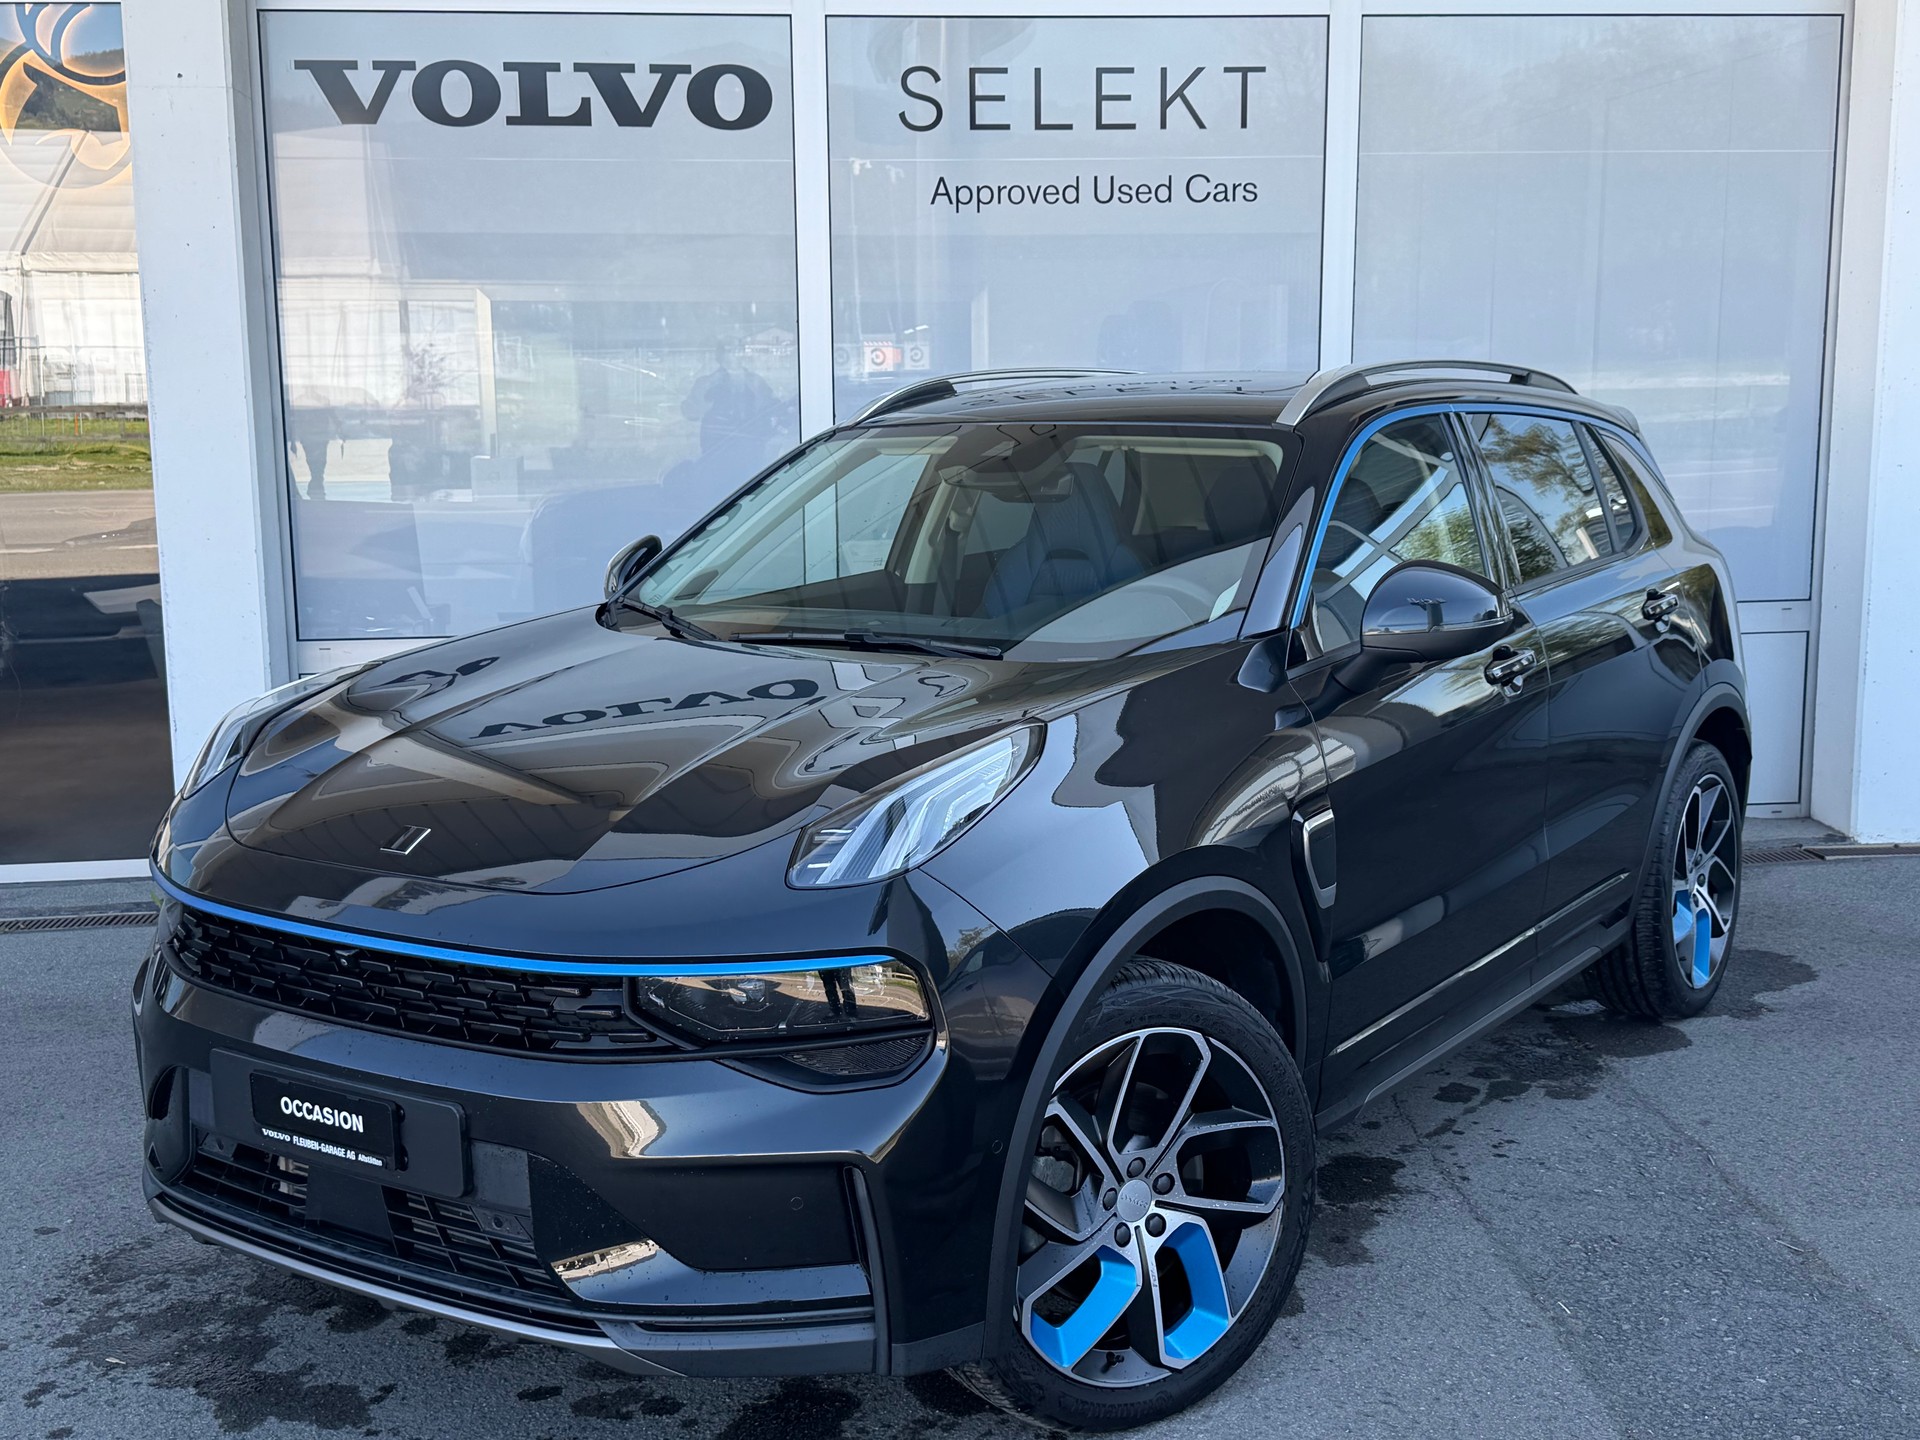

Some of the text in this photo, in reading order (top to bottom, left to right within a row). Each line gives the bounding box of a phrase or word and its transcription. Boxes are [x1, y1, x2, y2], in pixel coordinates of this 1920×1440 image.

[294, 59, 773, 130] VOLVO
[898, 66, 1267, 132] SELEKT
[930, 173, 1258, 213] Approved Used Cars
[280, 1096, 364, 1133] OCCASION
[262, 1128, 290, 1141] VOLVO
[346, 1150, 355, 1160] AG
